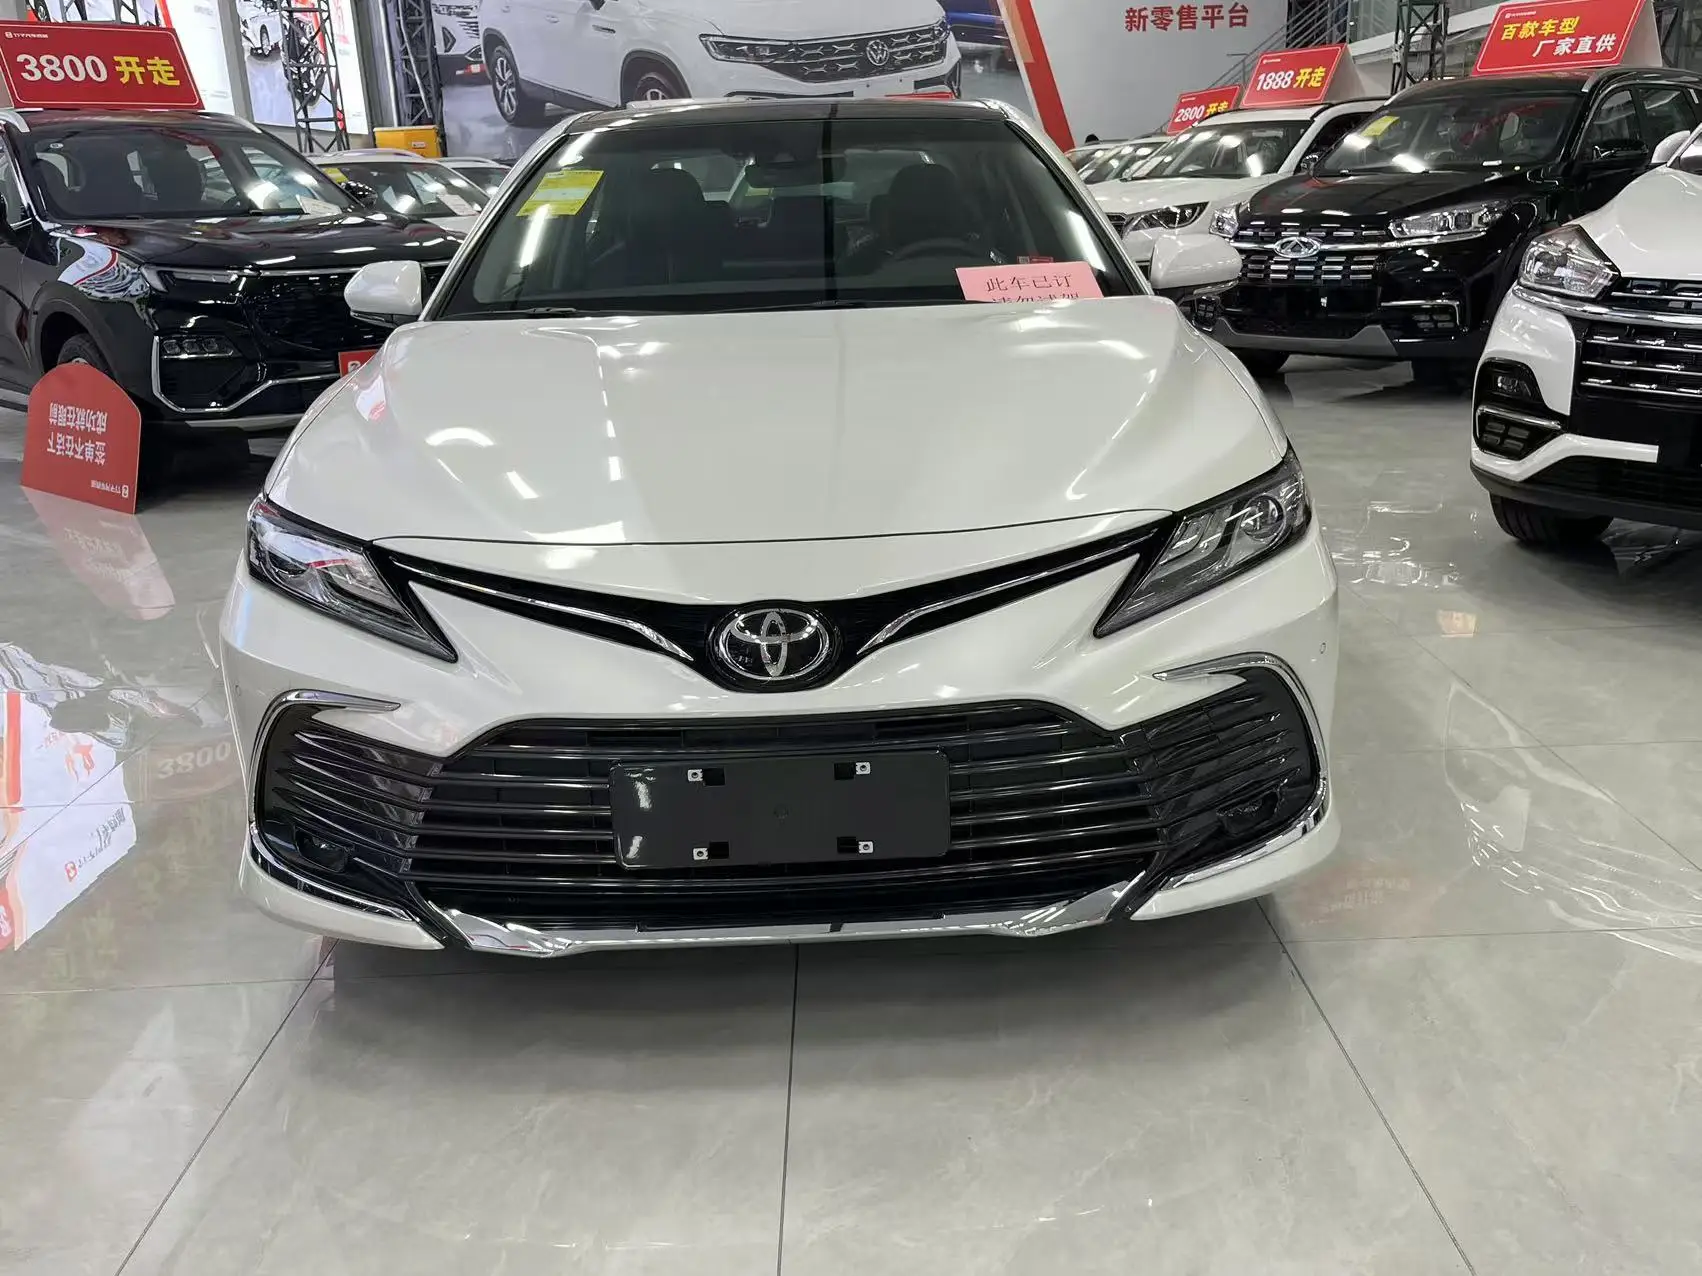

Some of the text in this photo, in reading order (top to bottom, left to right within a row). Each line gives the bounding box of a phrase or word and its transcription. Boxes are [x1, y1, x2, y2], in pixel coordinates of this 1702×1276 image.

[1124, 2, 1249, 32] 新零售平台
[1501, 16, 1580, 41] 百款车型
[1532, 33, 1617, 57] 厂家直供
[16, 54, 181, 86] 3800 开走
[1255, 66, 1327, 91] 1888 开走
[1174, 105, 1205, 122] 2800
[47, 431, 106, 466] 签单不在话下
